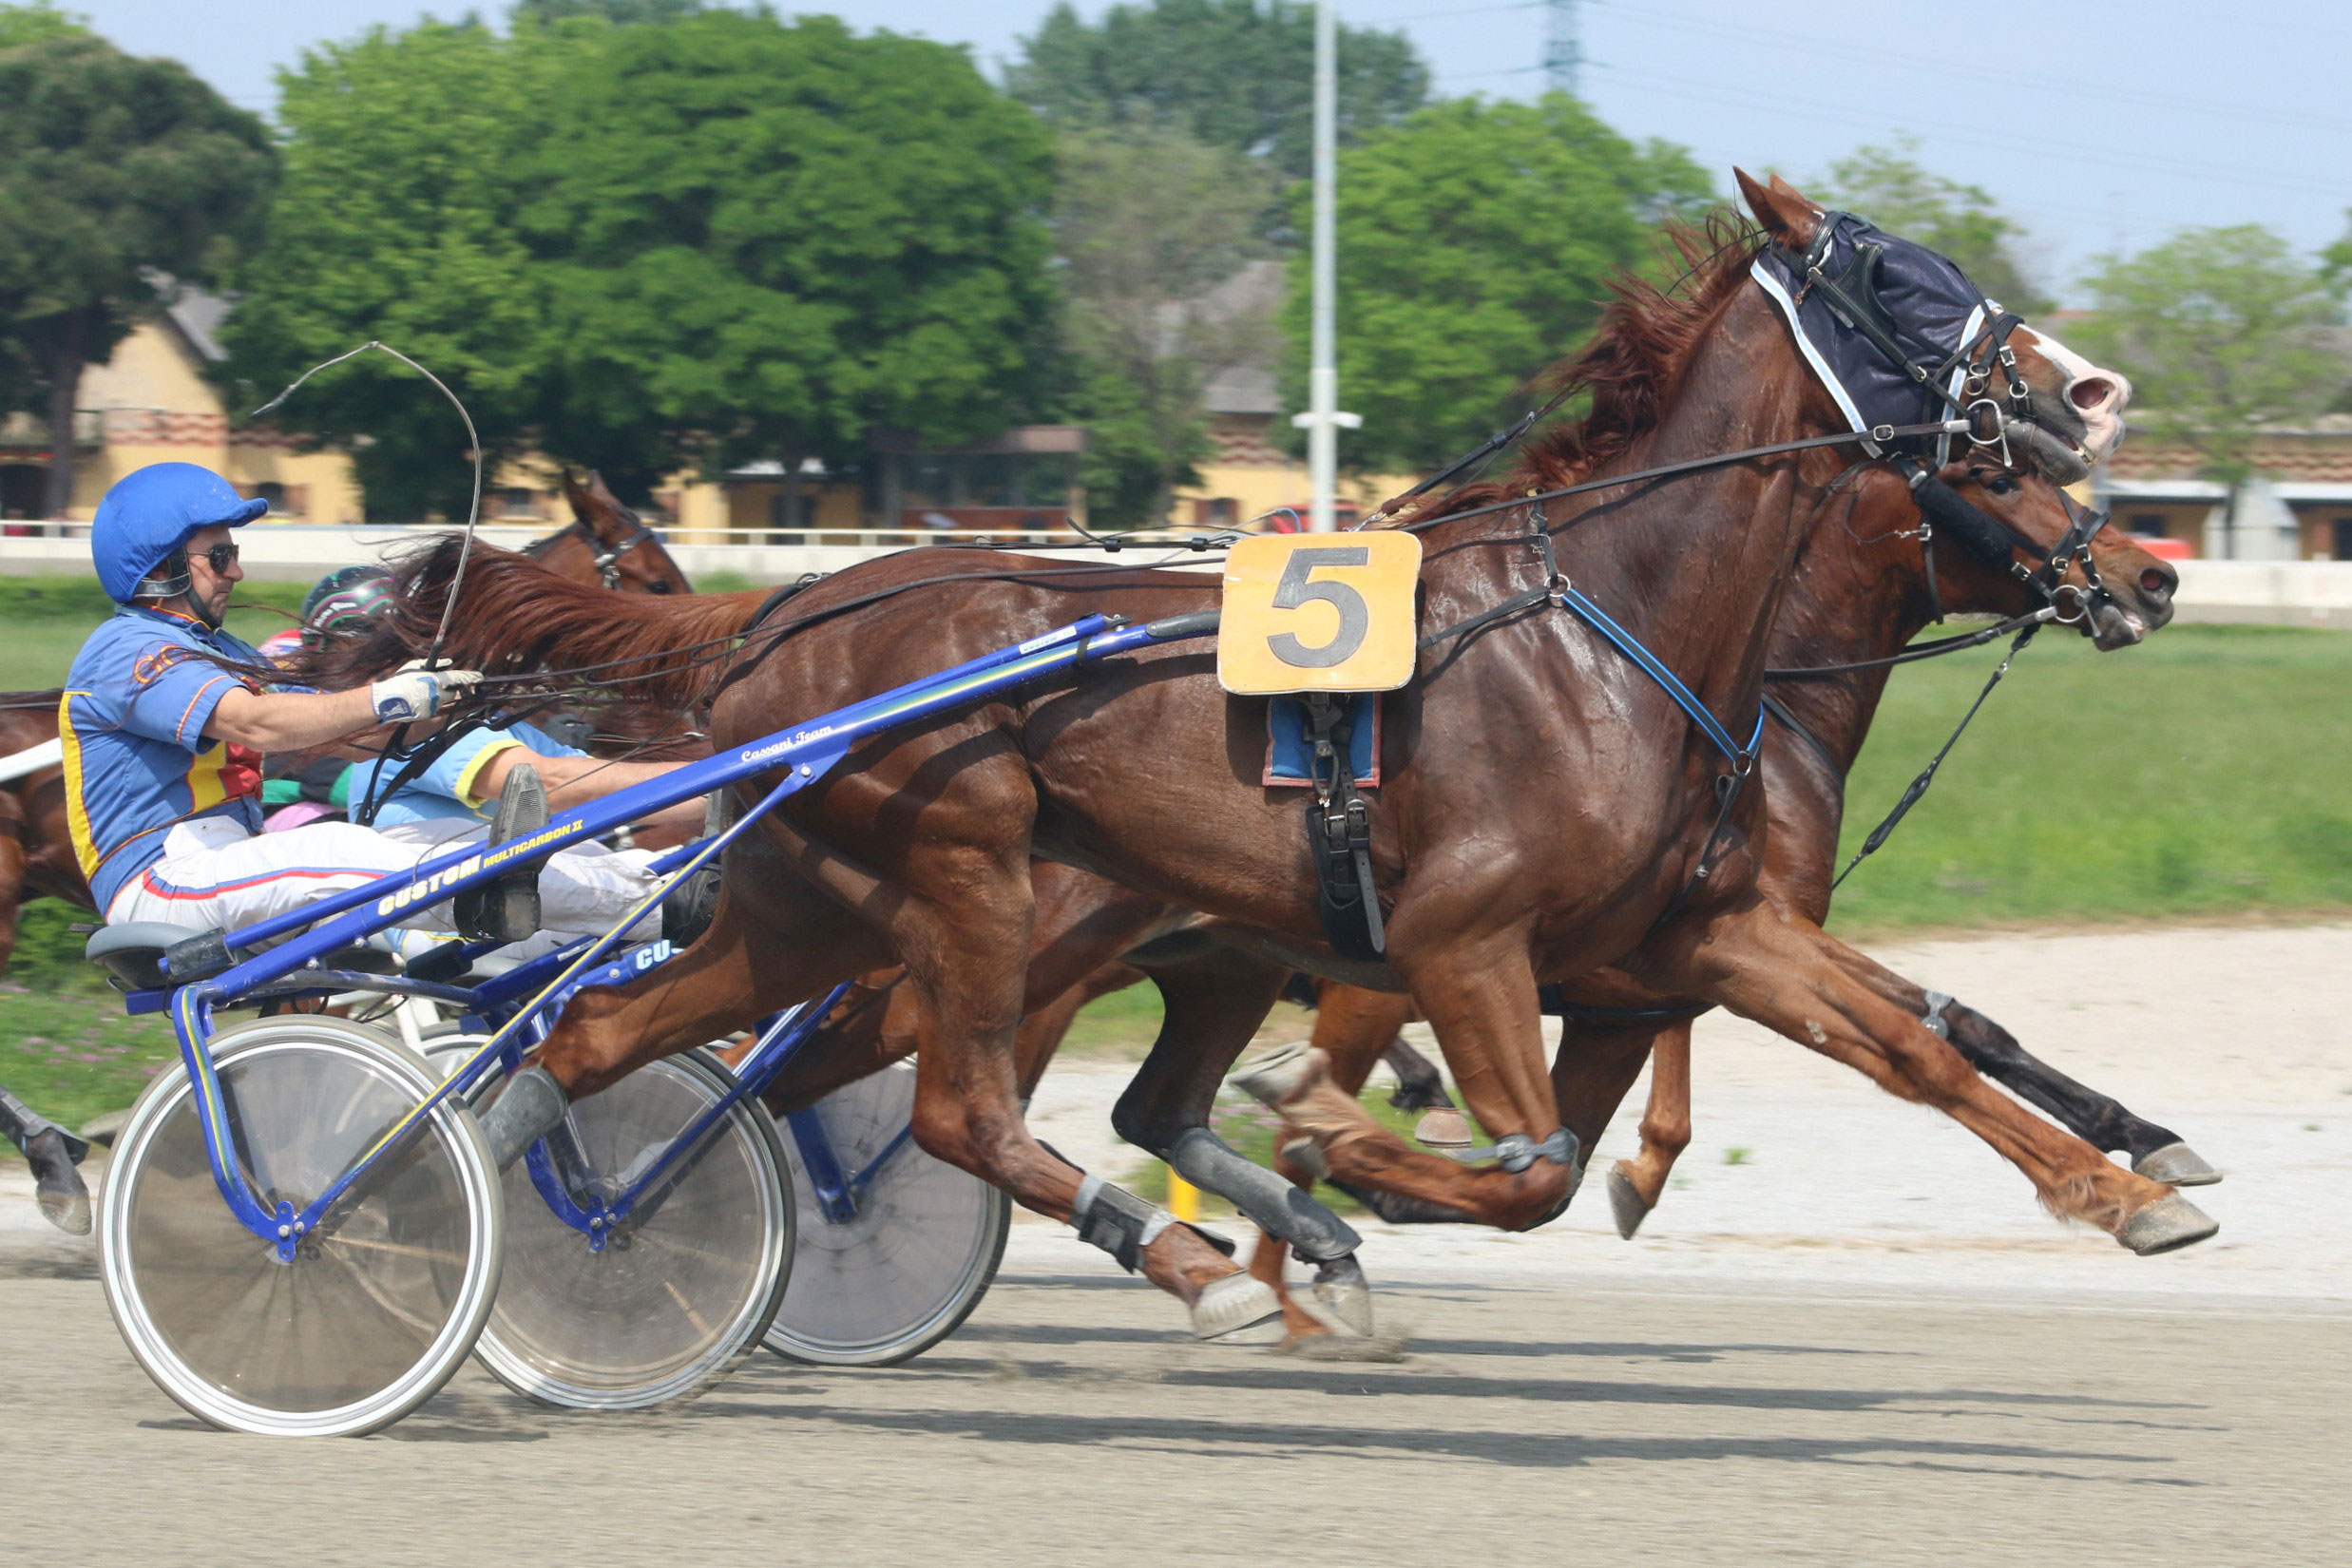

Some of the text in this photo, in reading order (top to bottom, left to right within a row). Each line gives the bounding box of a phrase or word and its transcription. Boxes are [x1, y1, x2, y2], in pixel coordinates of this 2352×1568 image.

[1267, 546, 1368, 668] 5
[741, 725, 832, 763] Cassani Team
[377, 854, 481, 916] CUSTOM
[484, 823, 571, 868] MULTICARBON
[636, 939, 685, 970] CU
